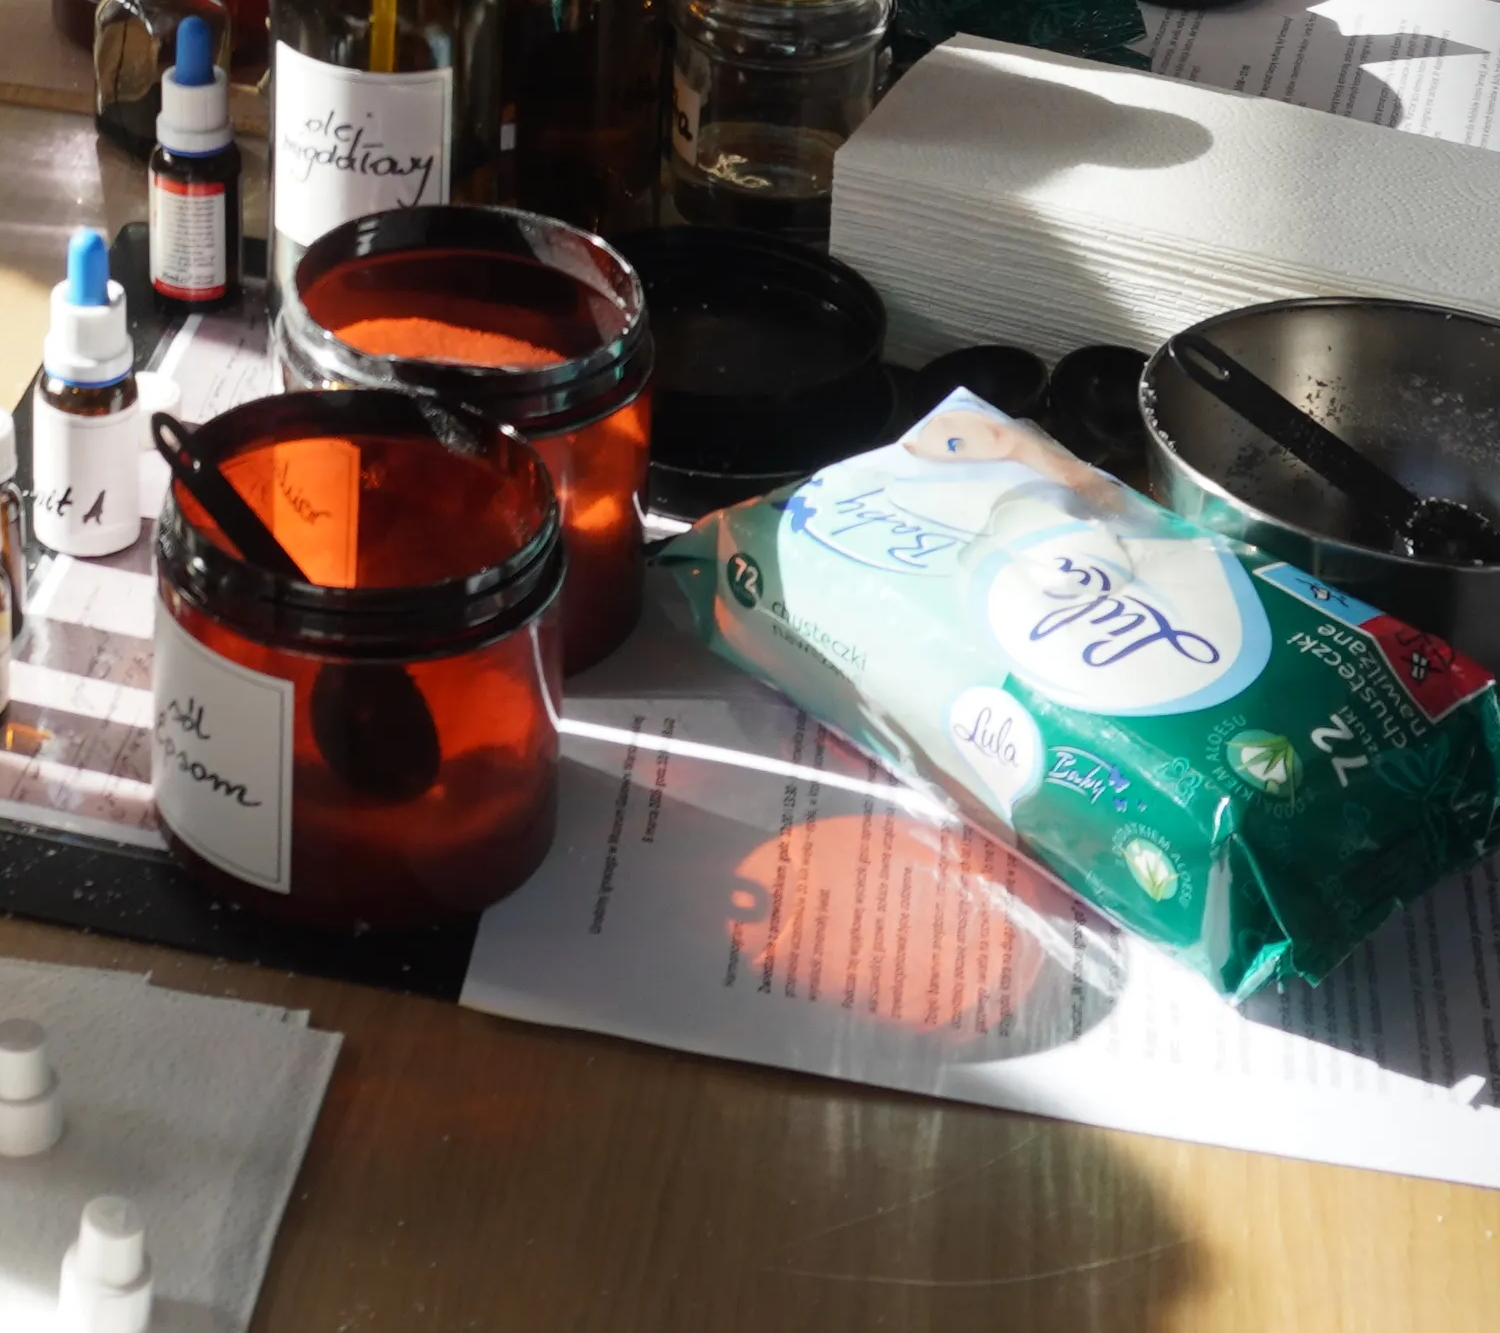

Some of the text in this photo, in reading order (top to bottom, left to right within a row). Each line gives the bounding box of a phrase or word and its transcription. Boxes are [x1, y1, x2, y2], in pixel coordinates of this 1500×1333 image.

[830, 487, 960, 569] Baby
[733, 556, 760, 596] 72
[1029, 552, 1222, 671] Lula
[770, 599, 869, 673] chusteczki
[1285, 631, 1409, 751] chusteczki
[1316, 622, 1429, 738] nawilżane
[953, 705, 1021, 769] Lula
[1204, 712, 1249, 763] ALOESU
[1310, 713, 1370, 788] 72
[1048, 748, 1108, 806] Baby
